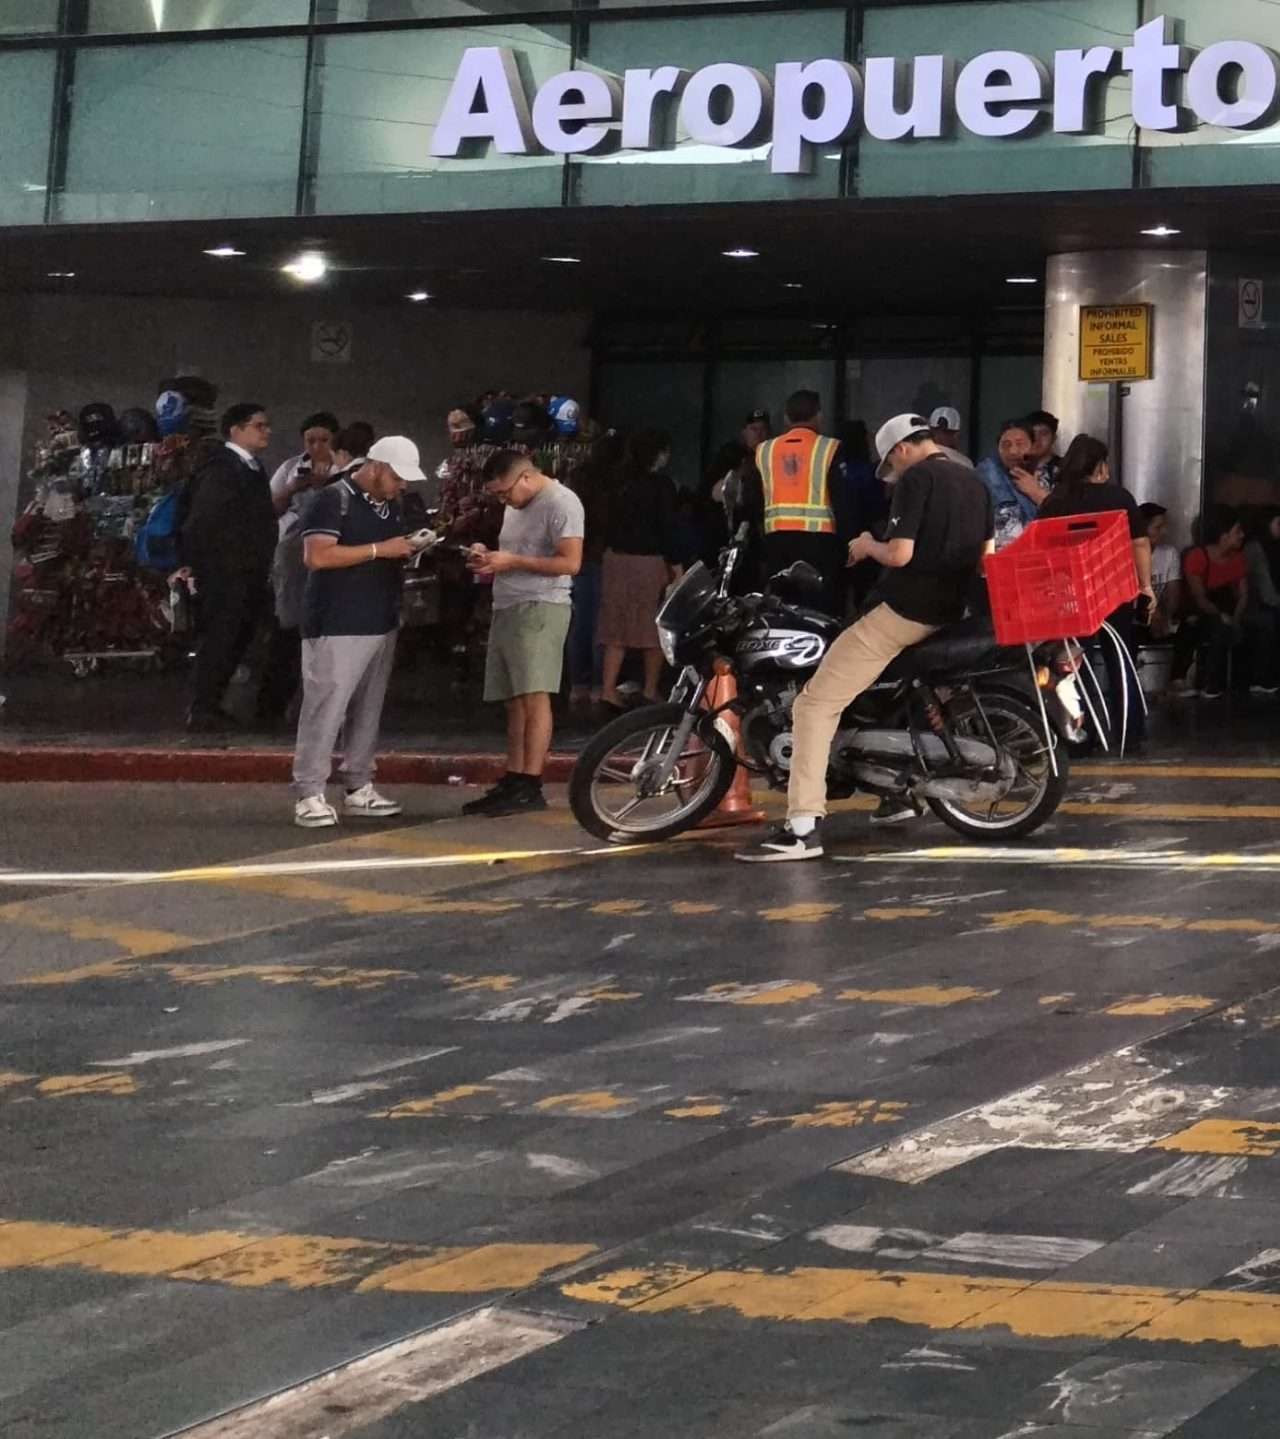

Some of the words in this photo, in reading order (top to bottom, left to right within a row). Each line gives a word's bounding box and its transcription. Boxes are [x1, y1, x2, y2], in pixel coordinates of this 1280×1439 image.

[1087, 308, 1142, 319] PROHIBITED
[1089, 321, 1137, 331] INFORMAL
[1099, 333, 1128, 343] SALES
